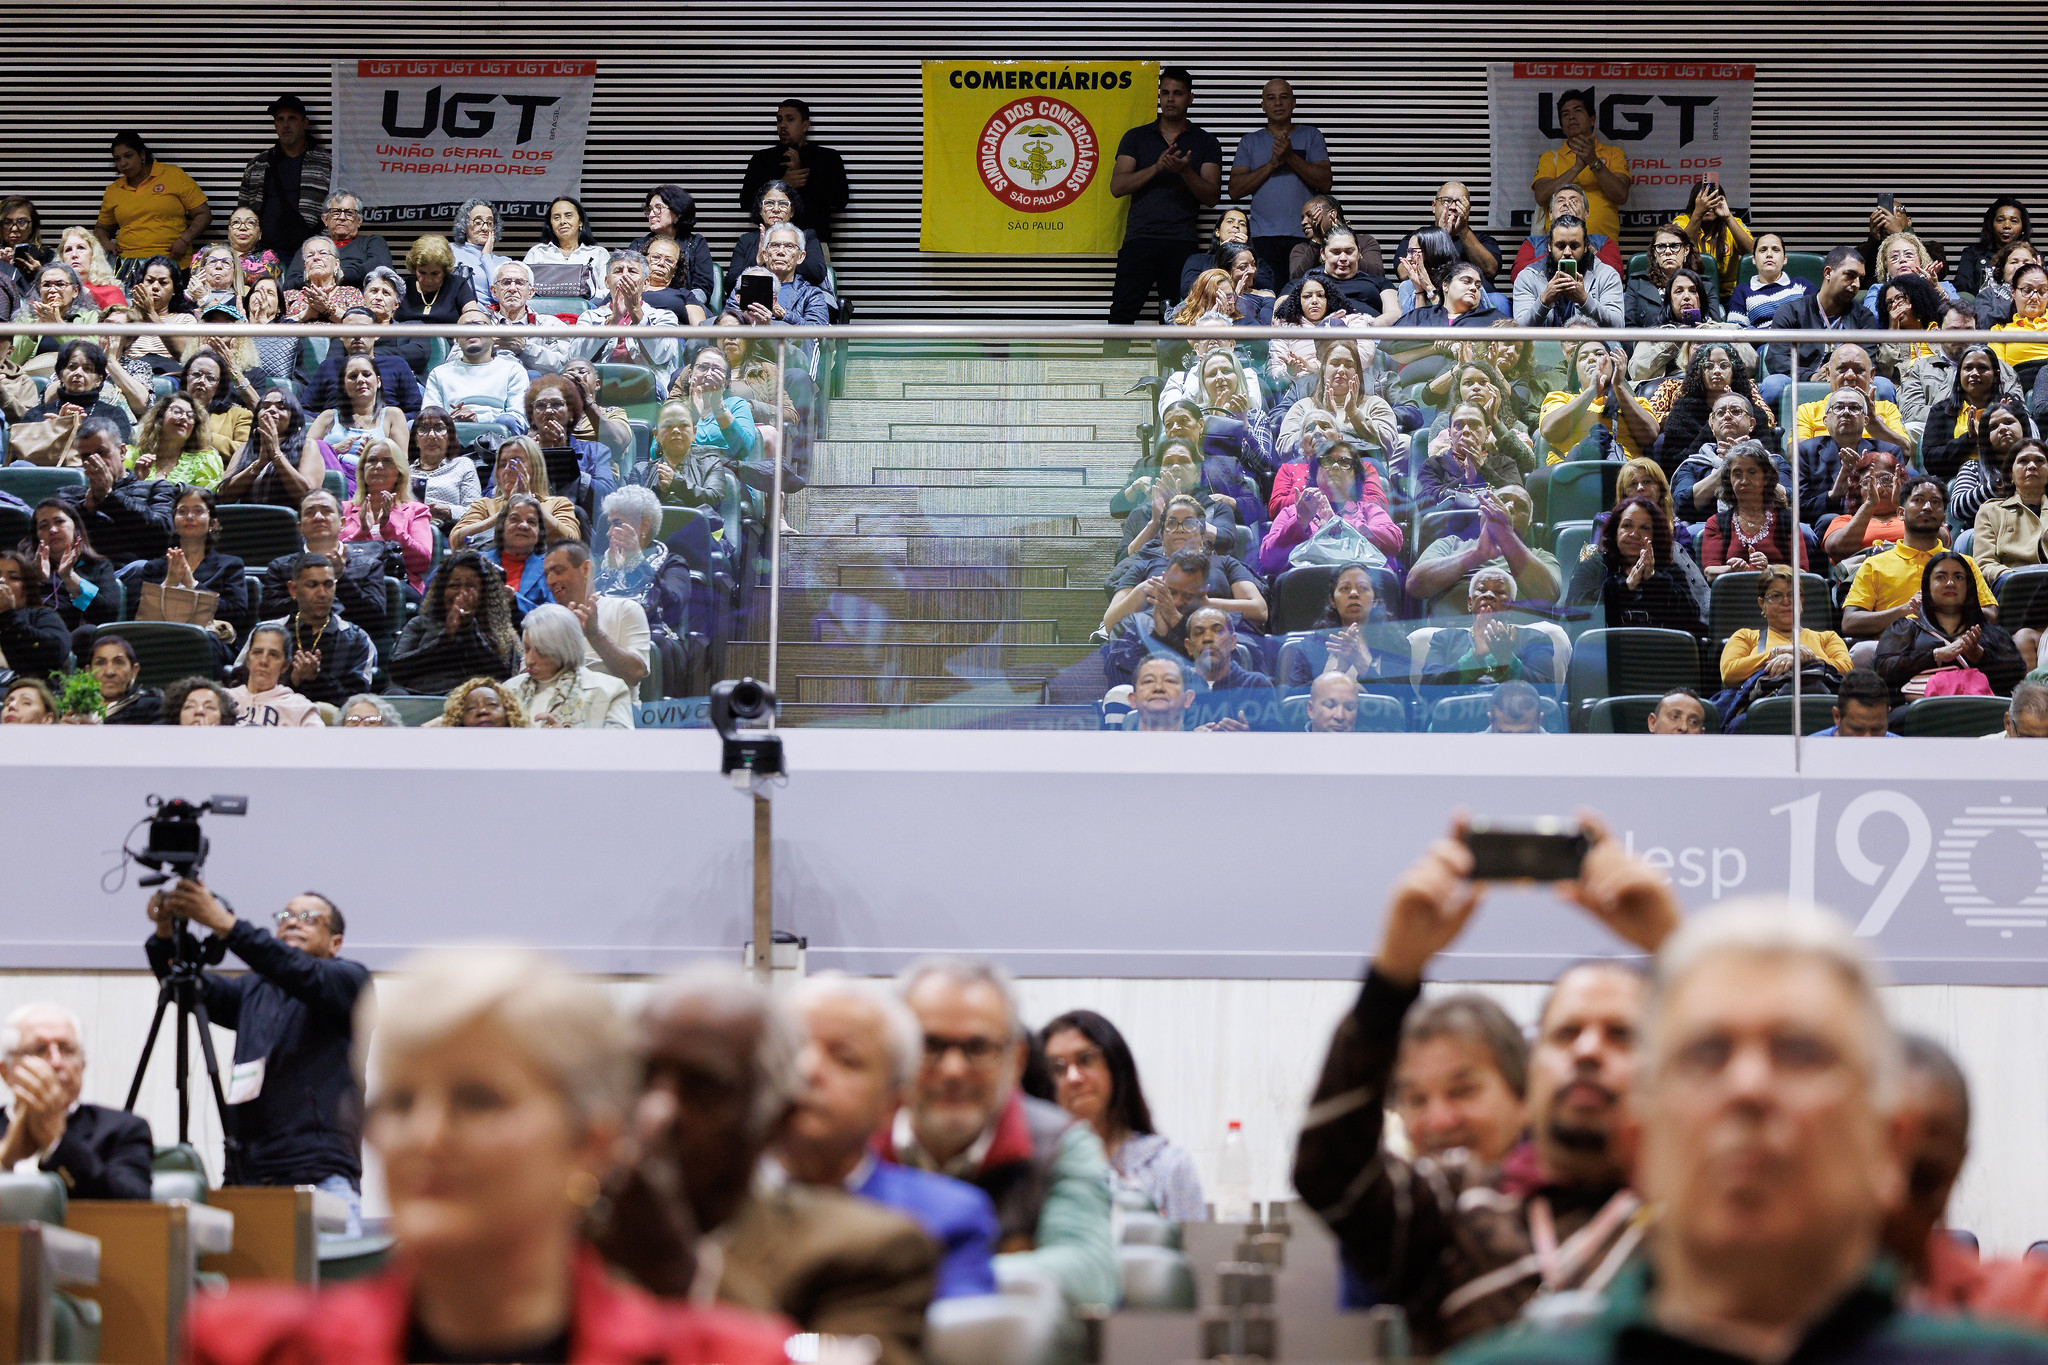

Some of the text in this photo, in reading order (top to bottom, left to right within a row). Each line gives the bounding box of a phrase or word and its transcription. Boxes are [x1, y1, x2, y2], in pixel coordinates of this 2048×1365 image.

[370, 62, 585, 75] UGT UGT UGT UGT UGT UGT
[1526, 64, 1744, 78] UGT UGT UGT UGT UGT UGT
[950, 66, 1132, 90] COMERCIÁRIOS
[381, 84, 562, 146] UGT
[549, 105, 561, 141] BRASIL
[1712, 105, 1720, 141] BRASIL
[376, 143, 553, 161] UNIÃO GERAL DOS
[981, 101, 1097, 193] SINDICATO DOS COMERCIÁRIOS
[378, 160, 546, 176] TRABALHADORES
[1629, 156, 1722, 170] RAL DOS
[1009, 190, 1066, 206] SÃO PAULO
[364, 209, 392, 222] UGT
[396, 207, 427, 220] UGT
[430, 205, 457, 217] UGT
[500, 204, 531, 215] UGT
[1631, 212, 1663, 225] UGT
[1007, 220, 1064, 231] SÃO PAULO
[1622, 830, 1748, 899] lesp
